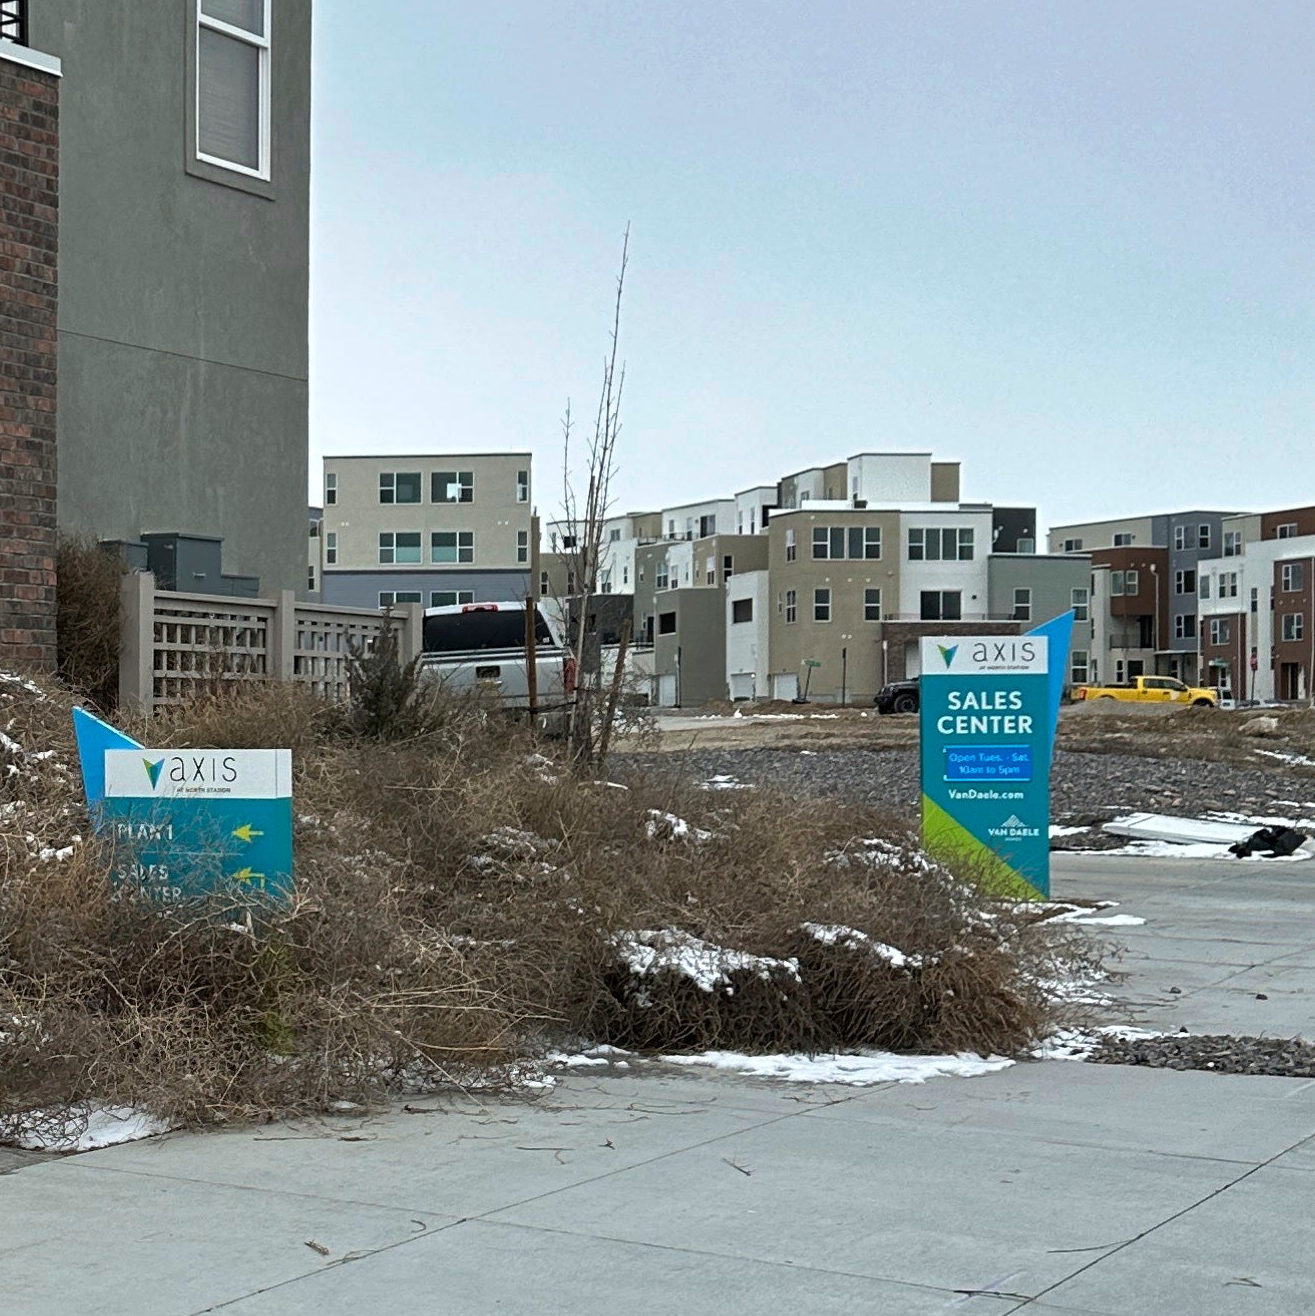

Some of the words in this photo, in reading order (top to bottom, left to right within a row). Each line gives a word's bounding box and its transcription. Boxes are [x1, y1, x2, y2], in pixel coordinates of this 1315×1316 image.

[972, 642, 1036, 663] axis
[947, 691, 1023, 710] SALES
[936, 715, 1033, 735] CENTER
[948, 752, 976, 763] Open
[170, 756, 237, 782] axis
[958, 765, 984, 775] 10am
[986, 765, 997, 774] to
[998, 765, 1021, 776] 5pm
[947, 789, 1025, 800] VanDaele.com
[987, 828, 1008, 836] VAN
[1009, 828, 1040, 836] DAELE
